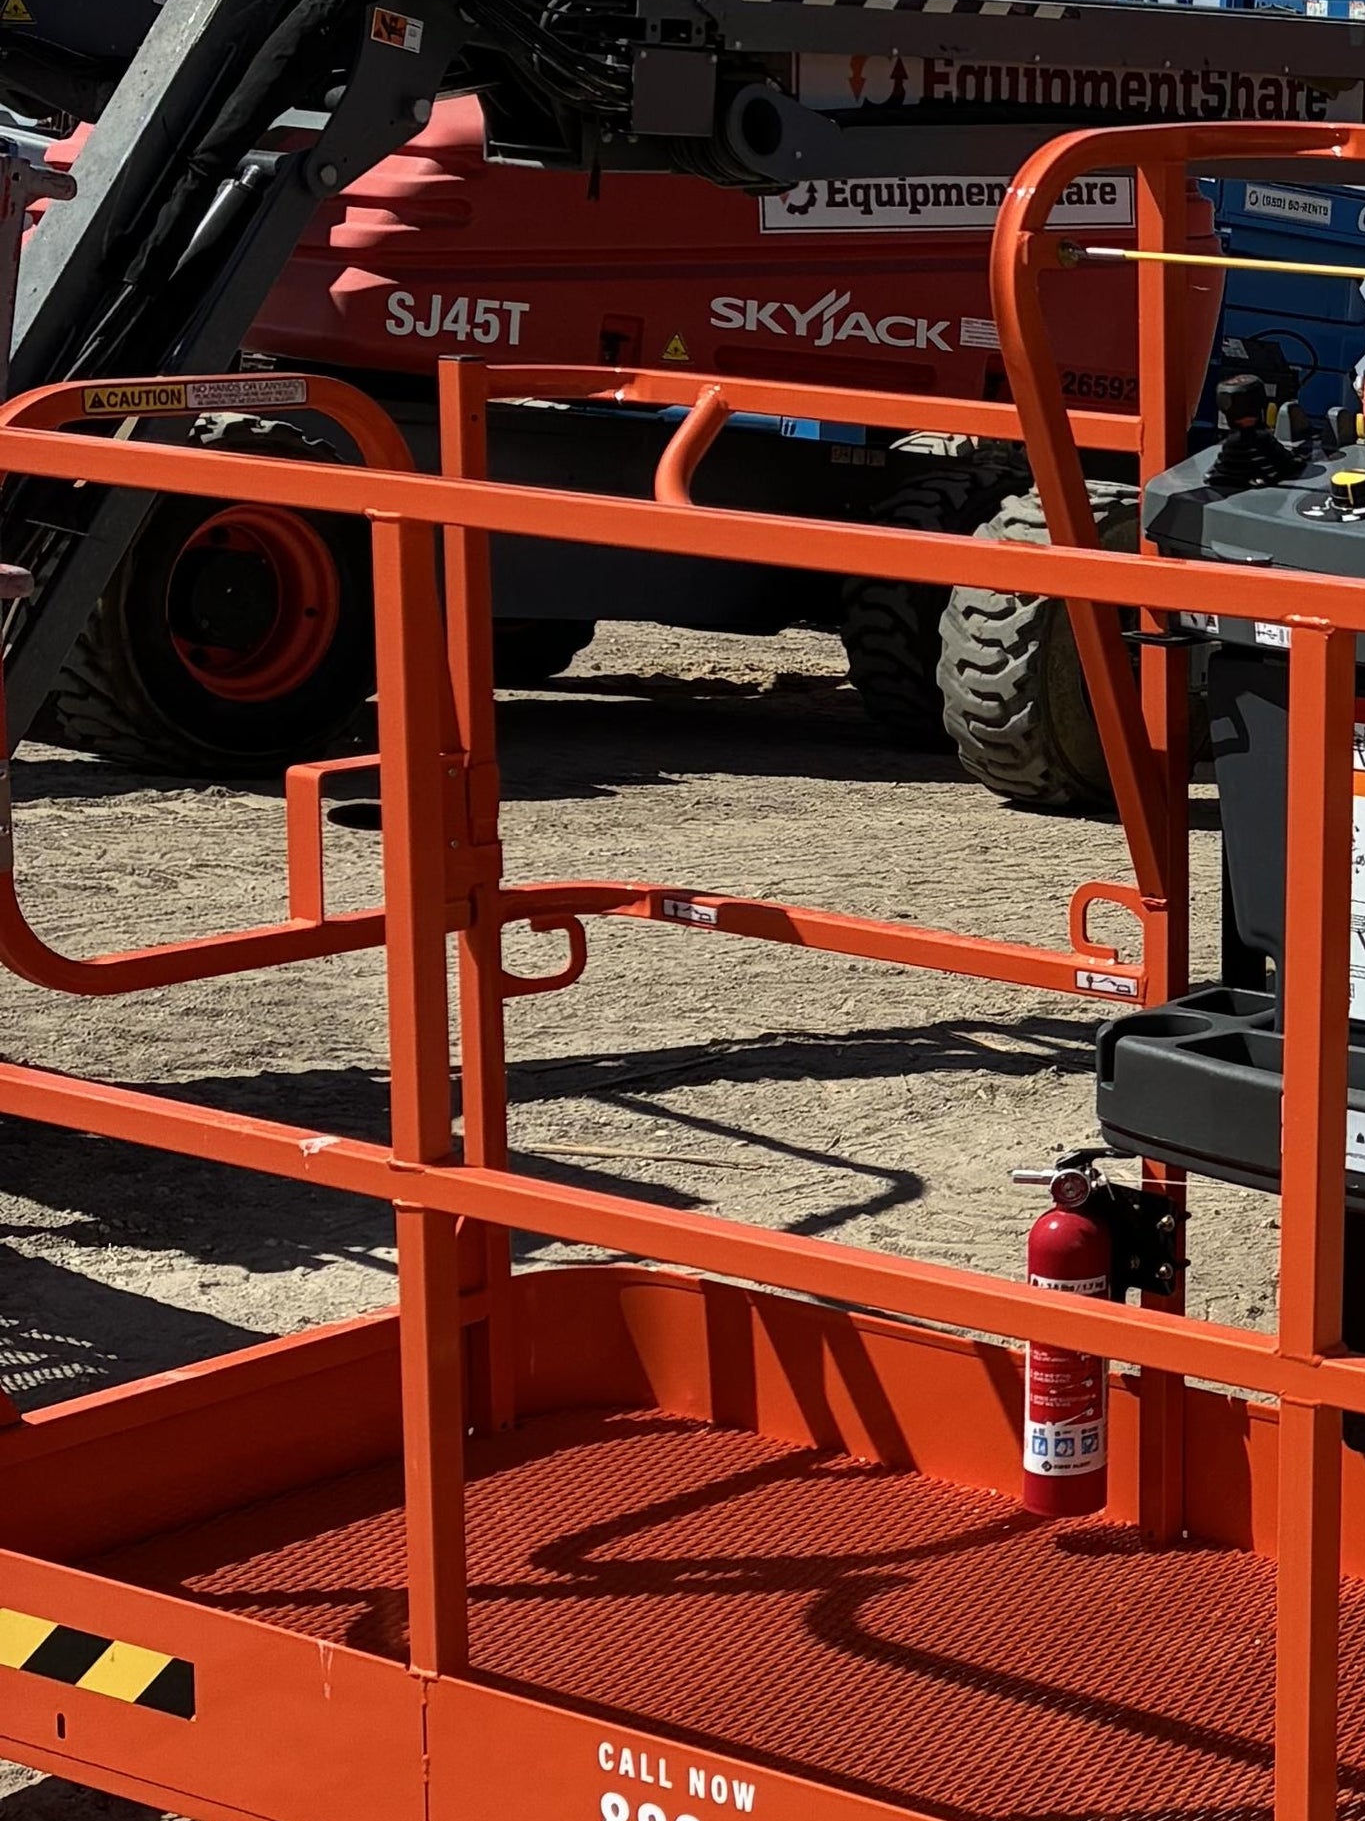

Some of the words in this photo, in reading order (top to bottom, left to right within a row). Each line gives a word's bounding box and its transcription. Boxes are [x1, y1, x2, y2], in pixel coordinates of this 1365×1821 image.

[386, 291, 530, 345] SJ45T
[709, 289, 953, 352] SKYJACK
[105, 387, 182, 409] CAUTION
[192, 384, 207, 393] NO
[598, 1741, 673, 1789] CALL
[689, 1766, 756, 1813] NOW
